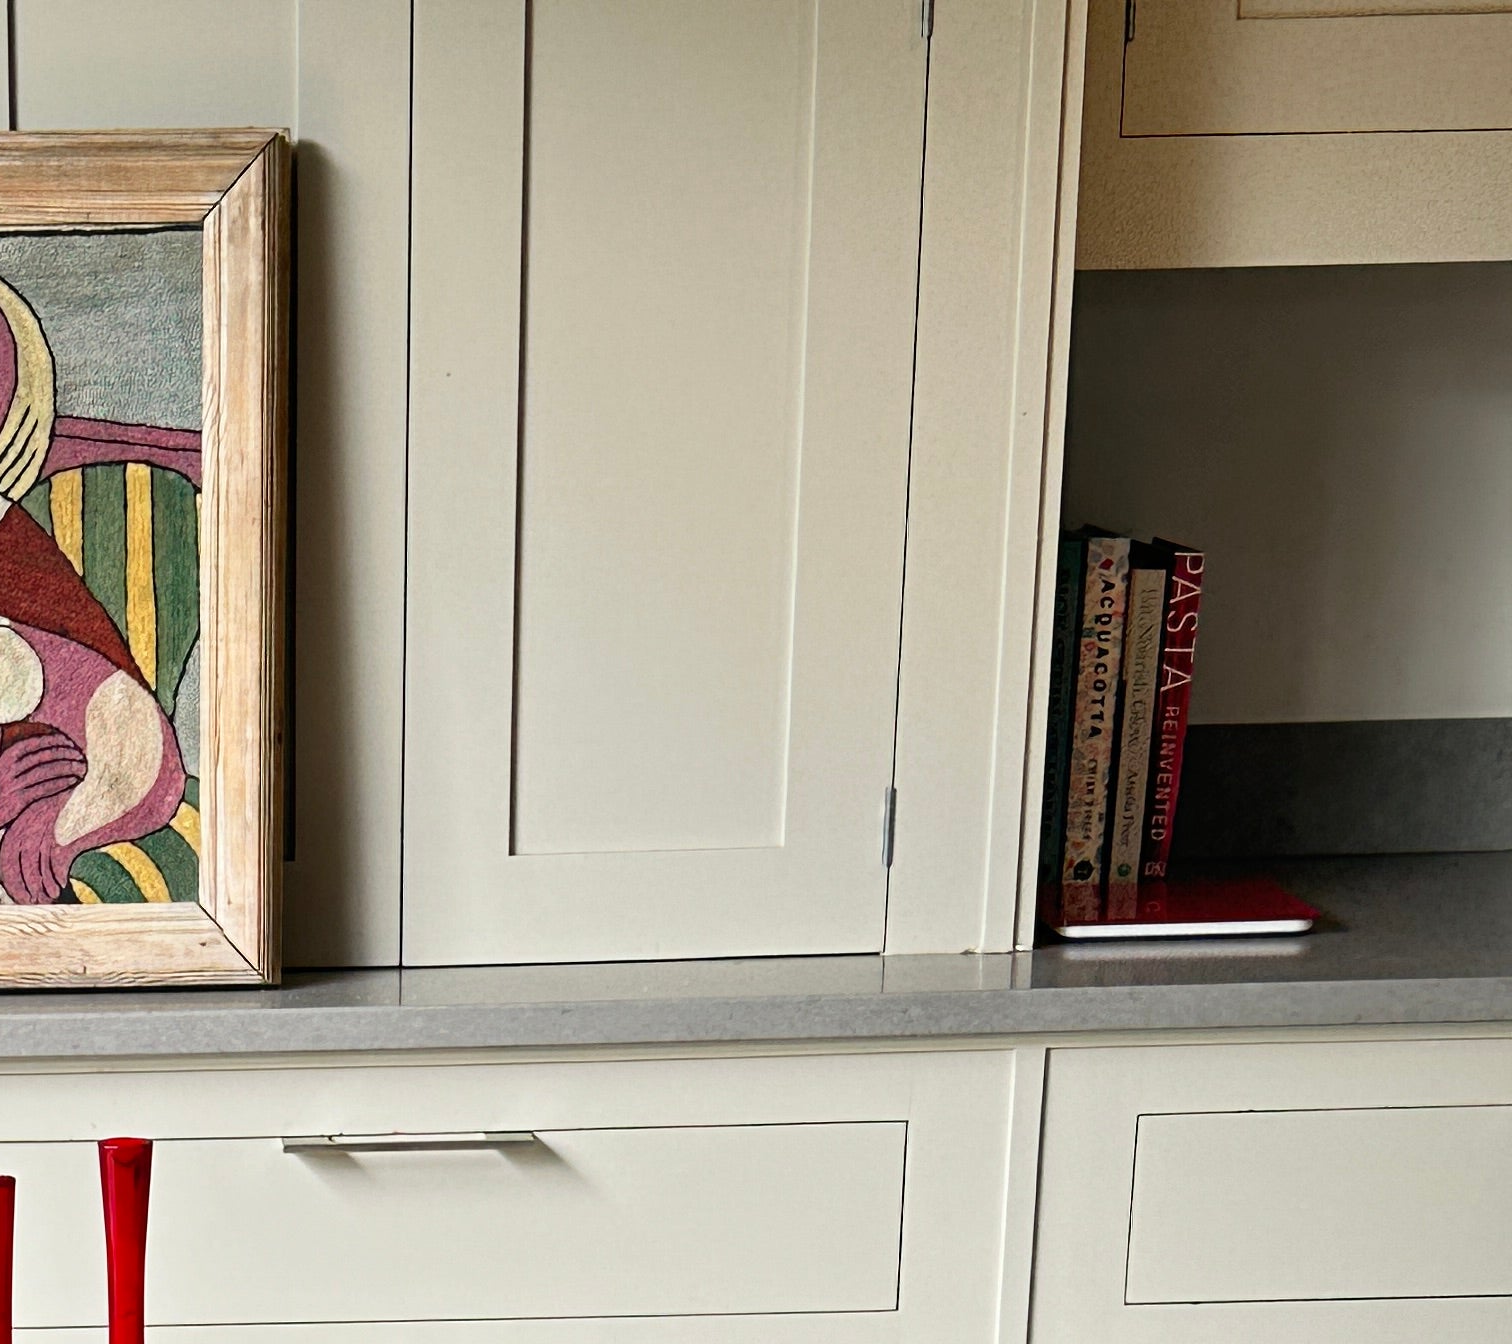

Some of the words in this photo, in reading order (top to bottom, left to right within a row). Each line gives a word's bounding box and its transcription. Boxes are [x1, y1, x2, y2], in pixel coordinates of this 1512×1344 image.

[1088, 578, 1116, 739] ACQUACOTTA
[1160, 552, 1205, 692] PASTA
[1150, 705, 1180, 841] REINVENTED
